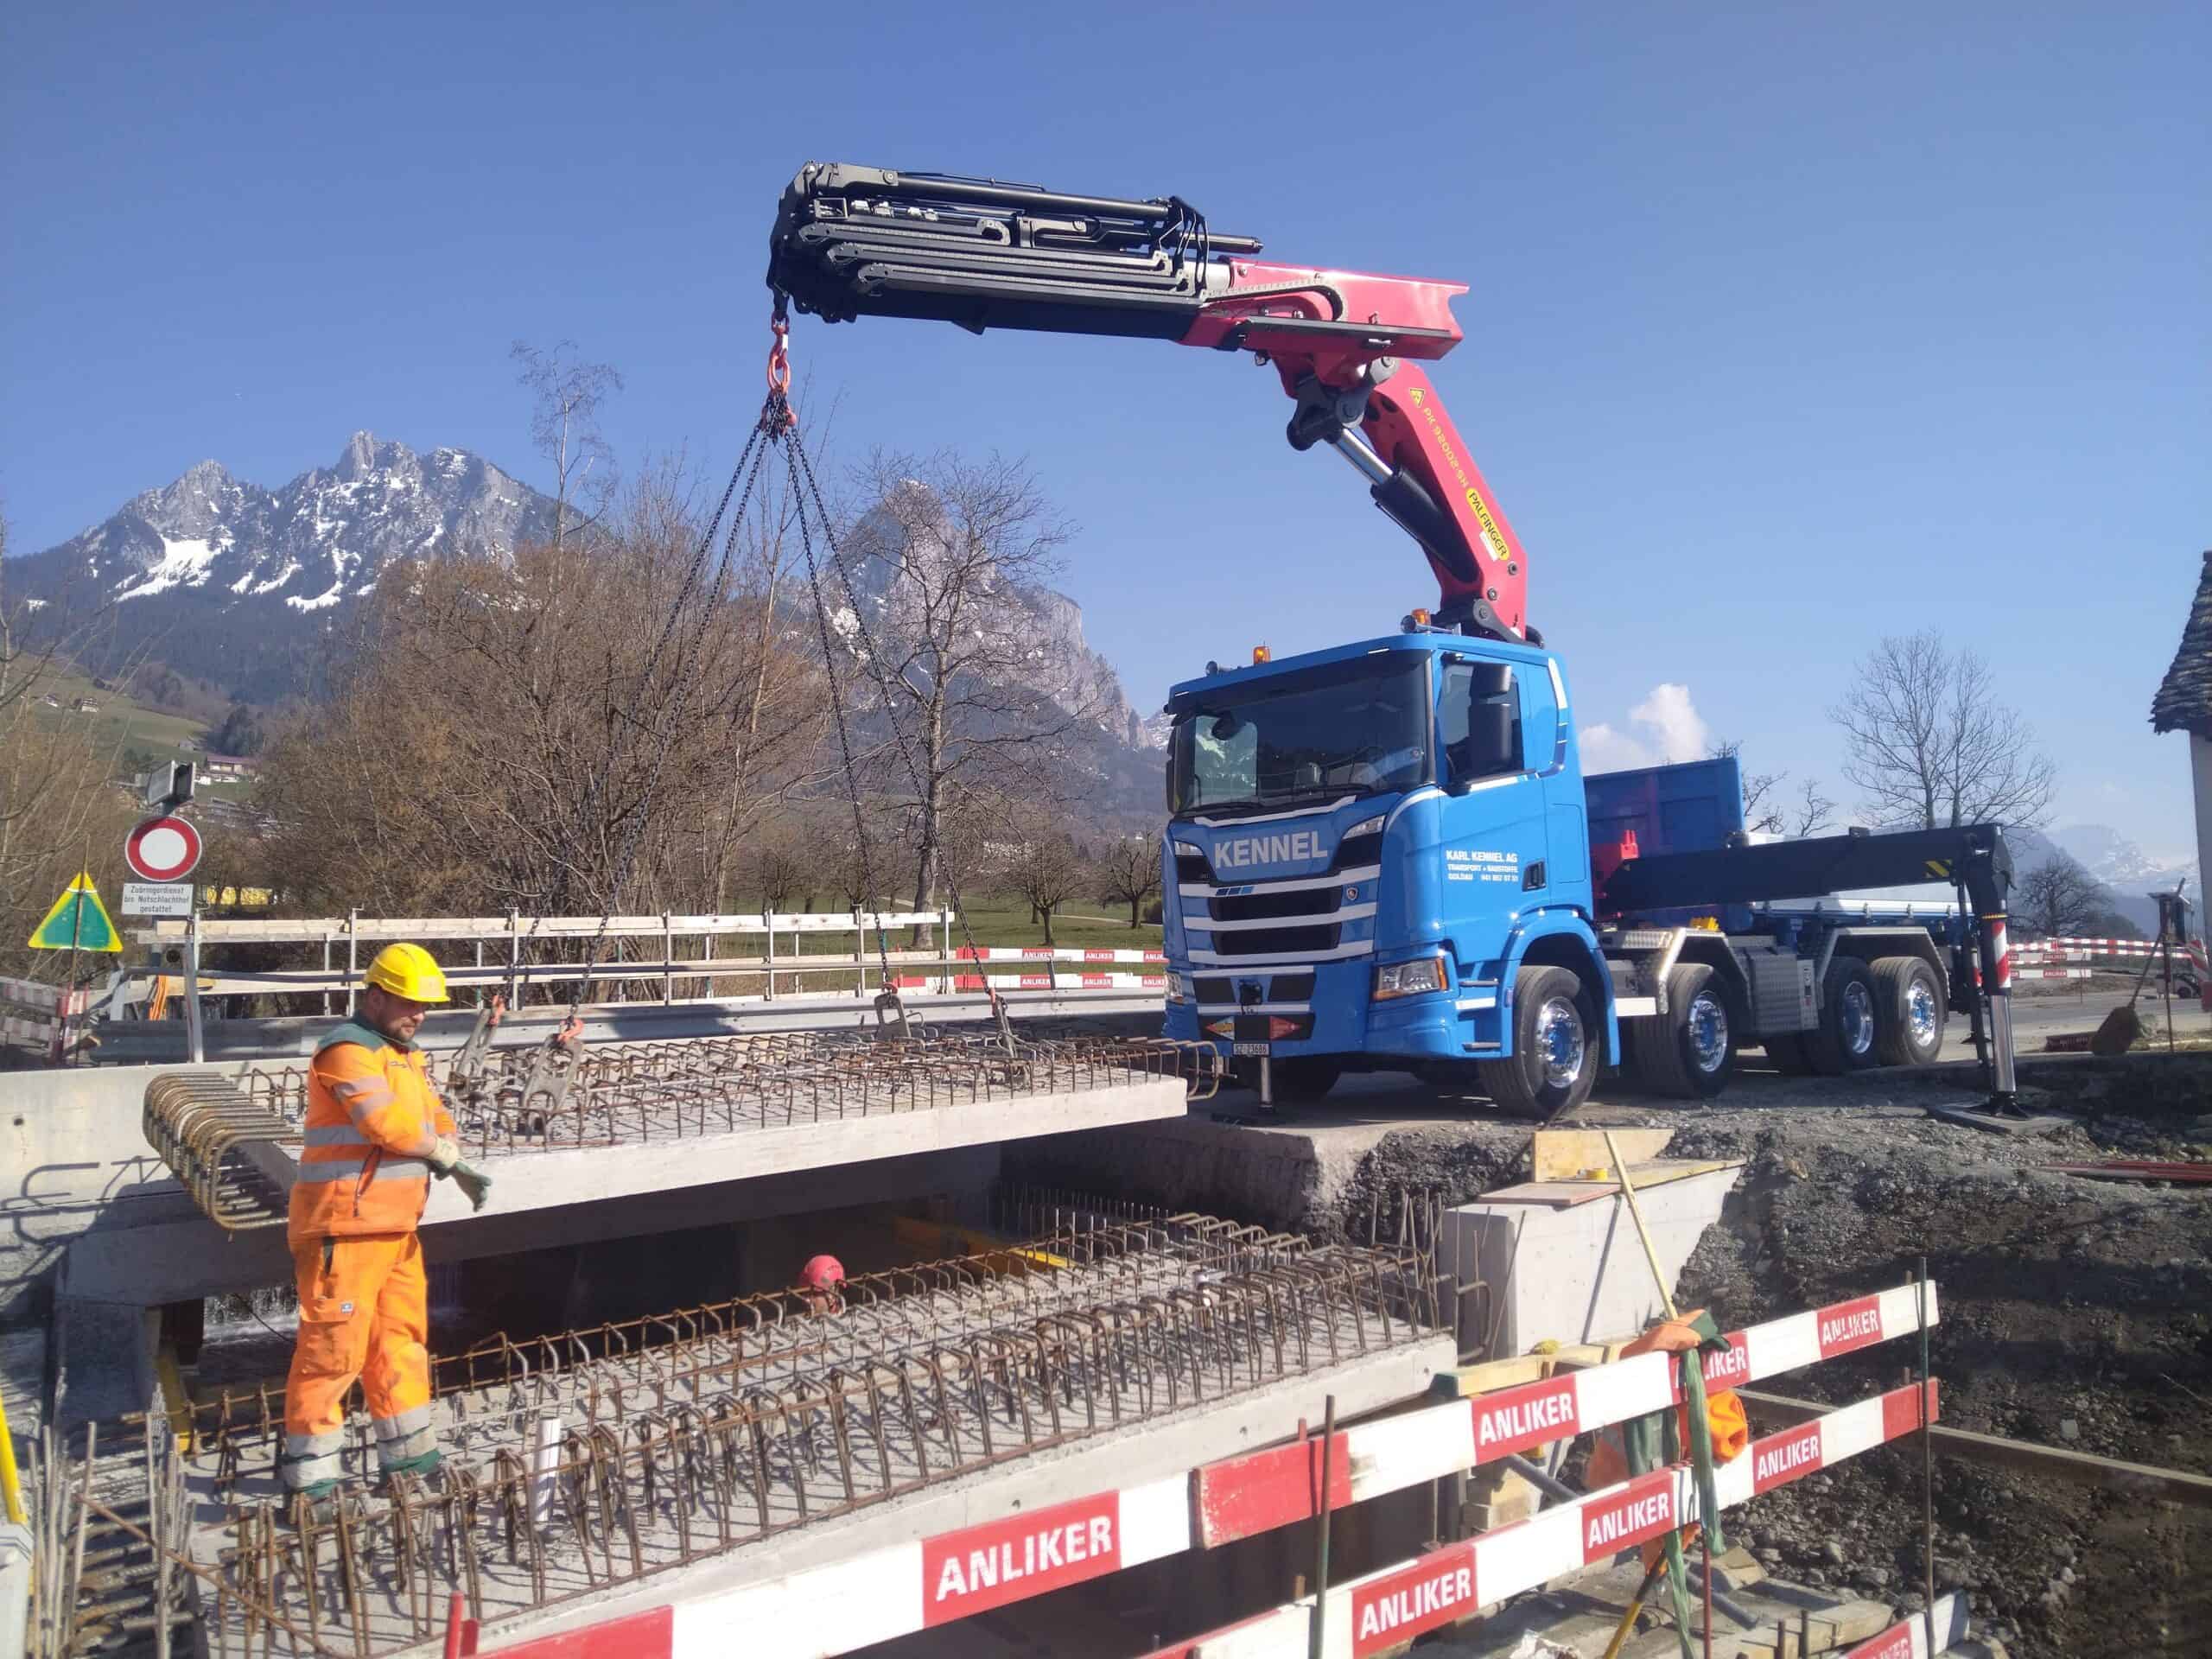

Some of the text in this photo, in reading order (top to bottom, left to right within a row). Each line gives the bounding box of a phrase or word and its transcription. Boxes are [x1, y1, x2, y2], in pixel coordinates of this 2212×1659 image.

[1468, 492, 1508, 556] PALFINGER
[1215, 830, 1328, 869] KENNEL
[1446, 850, 1518, 862] KARL KENNEL AG
[1821, 1310, 1878, 1345] ANLIKER
[1479, 1392, 1574, 1446] ANLIKER
[1757, 1435, 1819, 1481] ANLIKER
[1587, 1492, 1669, 1549] ANLIKER
[936, 1515, 1113, 1602] ANLIKER
[1359, 1567, 1471, 1641] ANLIKER
